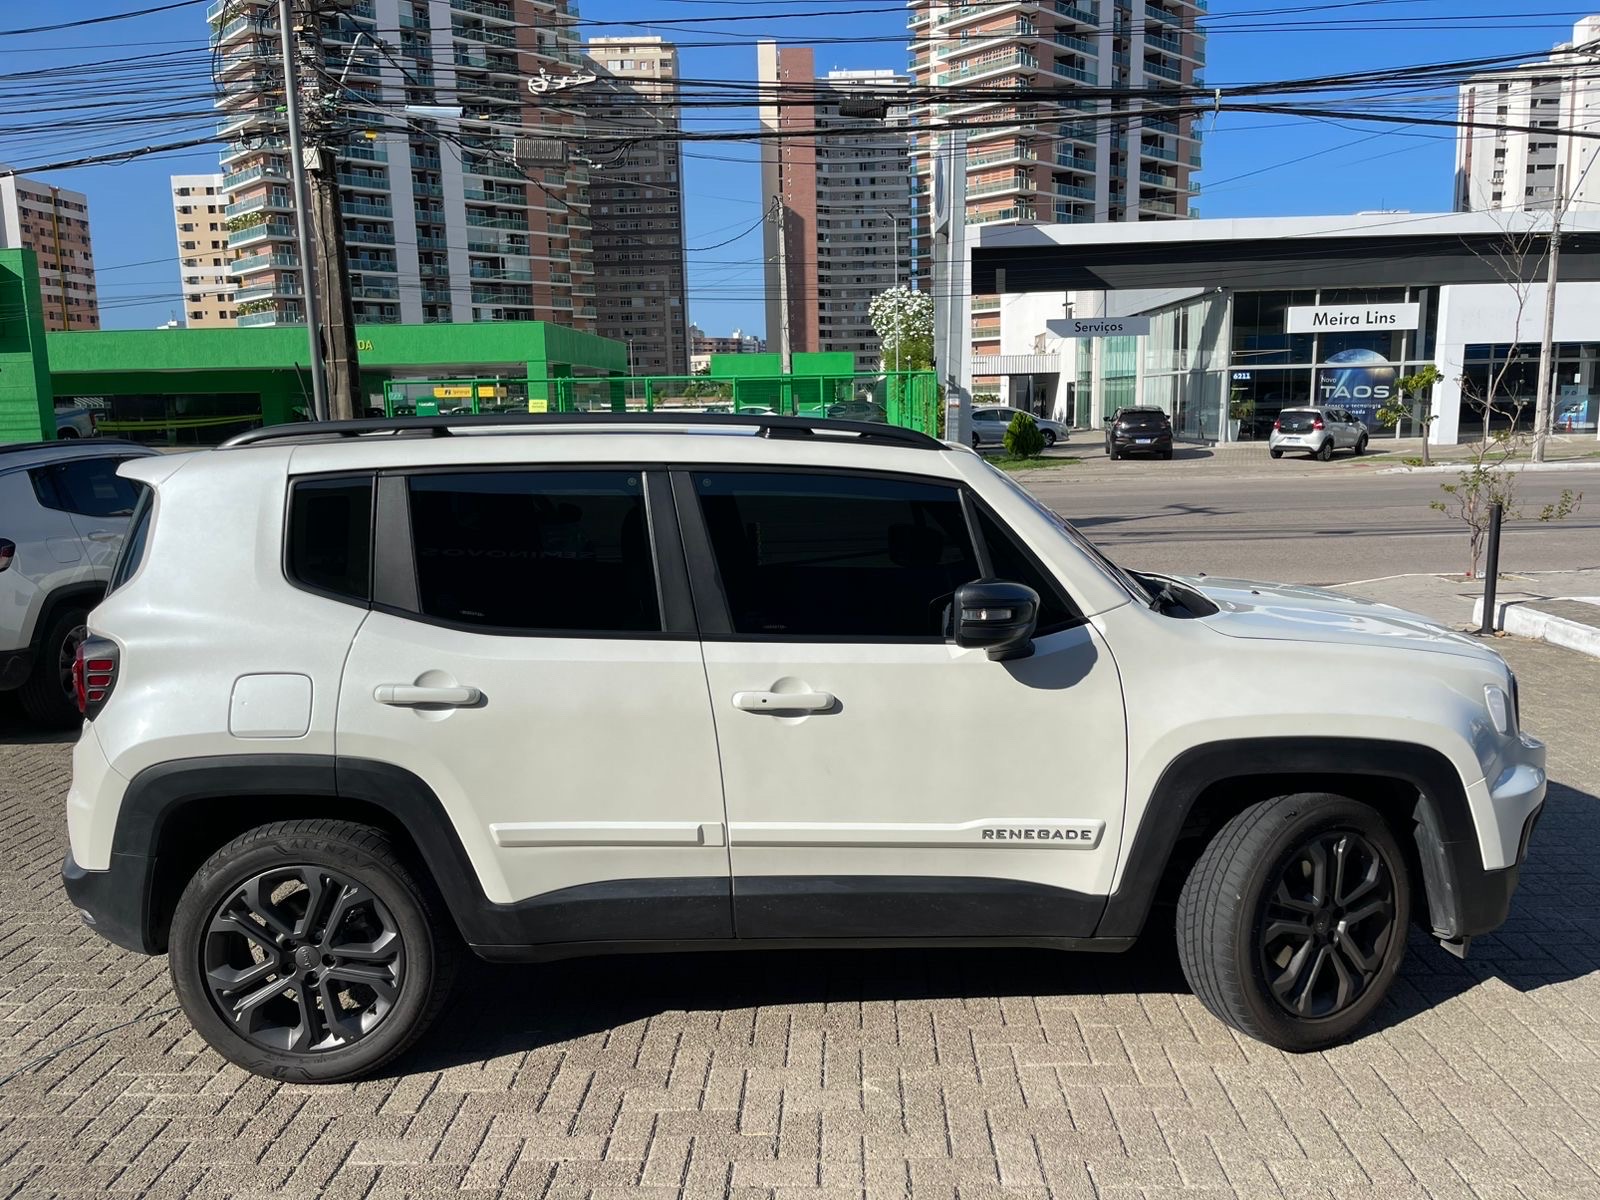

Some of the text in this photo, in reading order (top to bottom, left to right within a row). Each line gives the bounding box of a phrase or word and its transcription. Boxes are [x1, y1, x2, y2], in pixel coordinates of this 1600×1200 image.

[1312, 310, 1397, 326] Meira Lins
[1074, 321, 1123, 335] Serviços
[1232, 372, 1251, 380] 6211
[1320, 374, 1337, 383] Novo
[1320, 385, 1390, 399] TAOS
[981, 829, 1092, 841] RENEGADE
